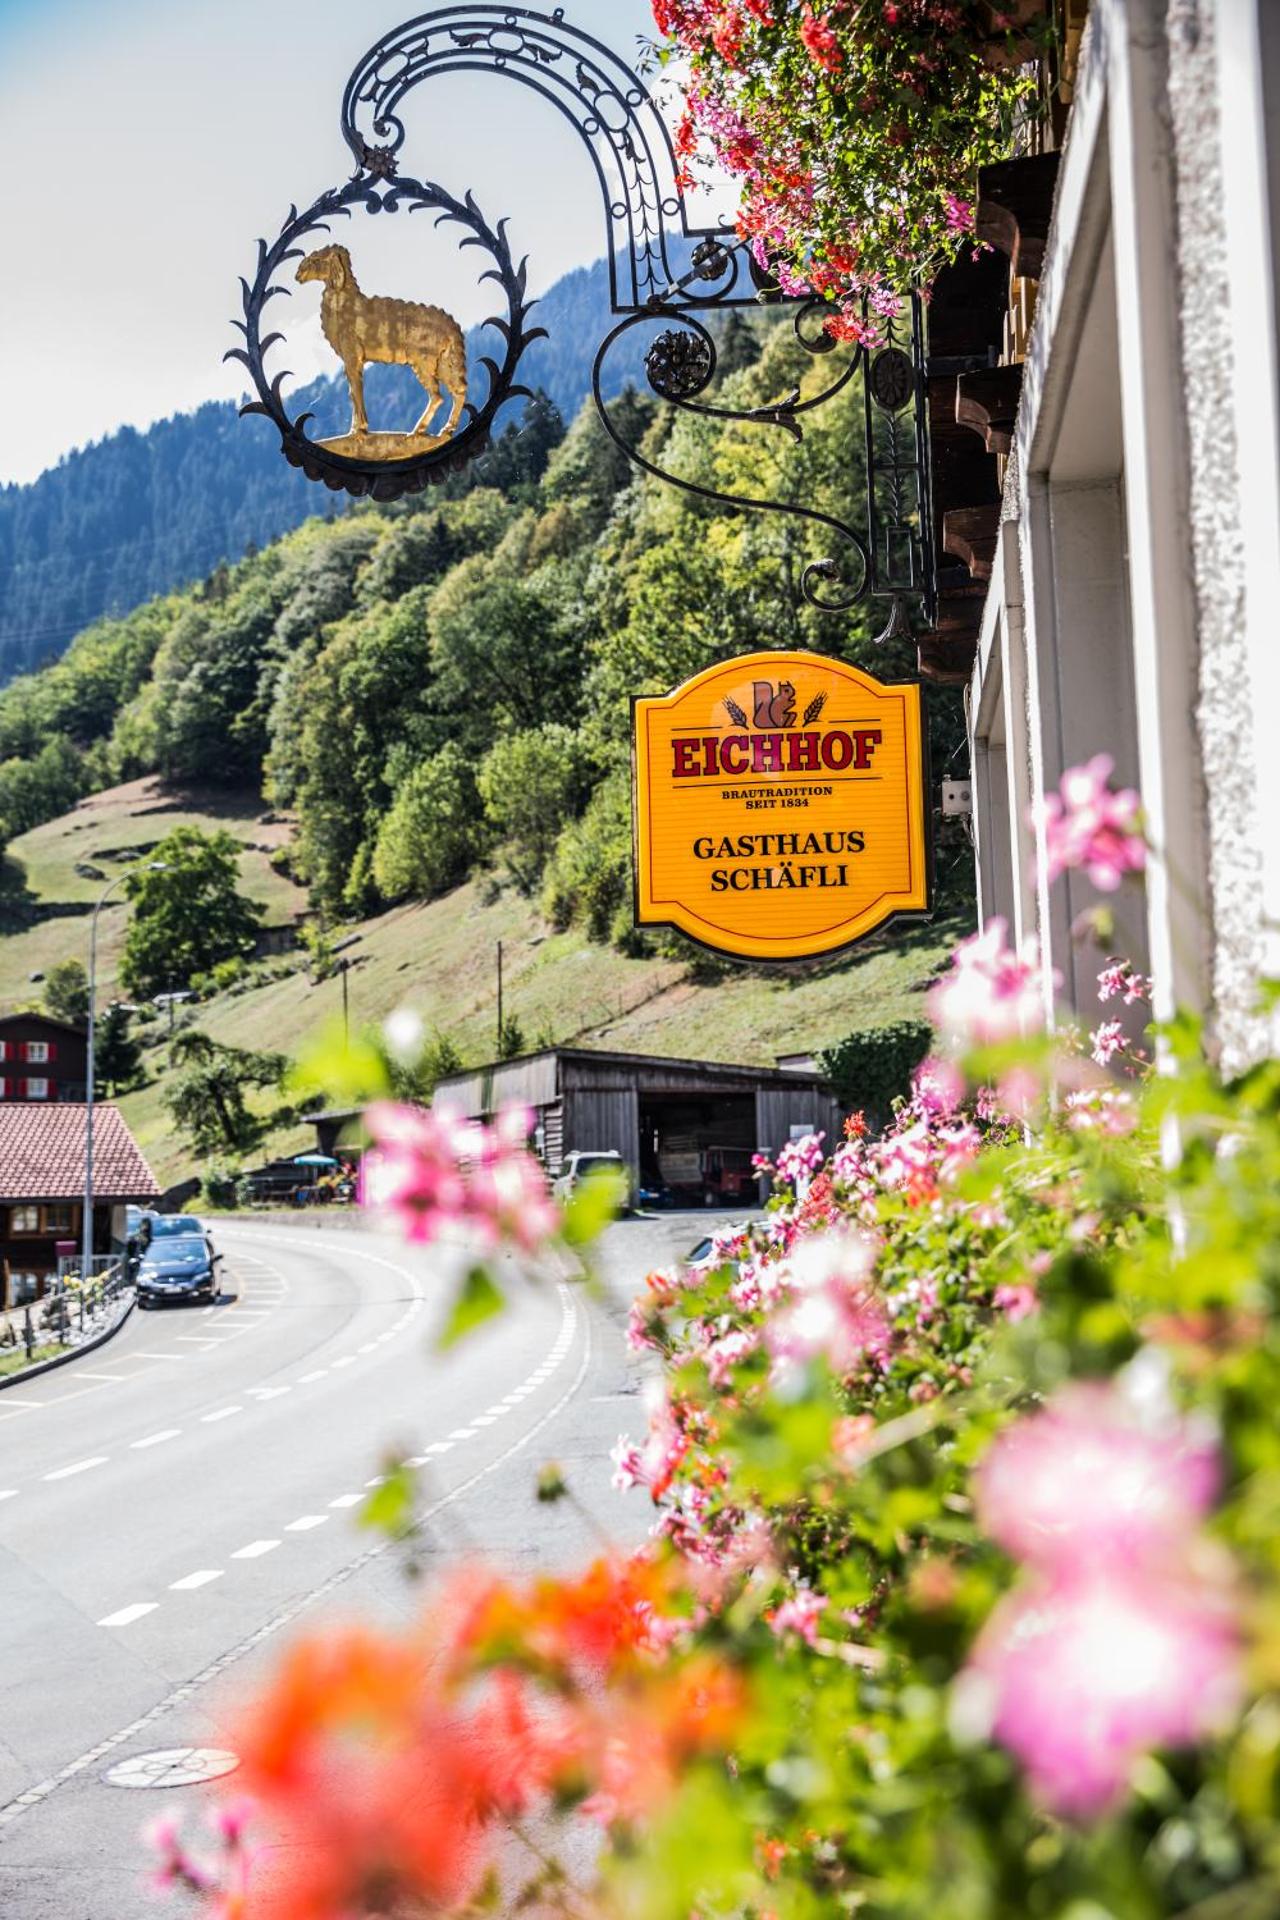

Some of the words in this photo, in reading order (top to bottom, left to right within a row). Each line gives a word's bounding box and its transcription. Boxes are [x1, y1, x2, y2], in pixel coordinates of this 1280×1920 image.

[671, 729, 883, 778] EICHHOF
[722, 786, 833, 800] BRAUTRADITION
[745, 799, 777, 810] SEIT
[781, 798, 809, 808] 1834
[693, 831, 865, 860] GASTHAUS
[711, 861, 849, 891] SCHÄFLI
